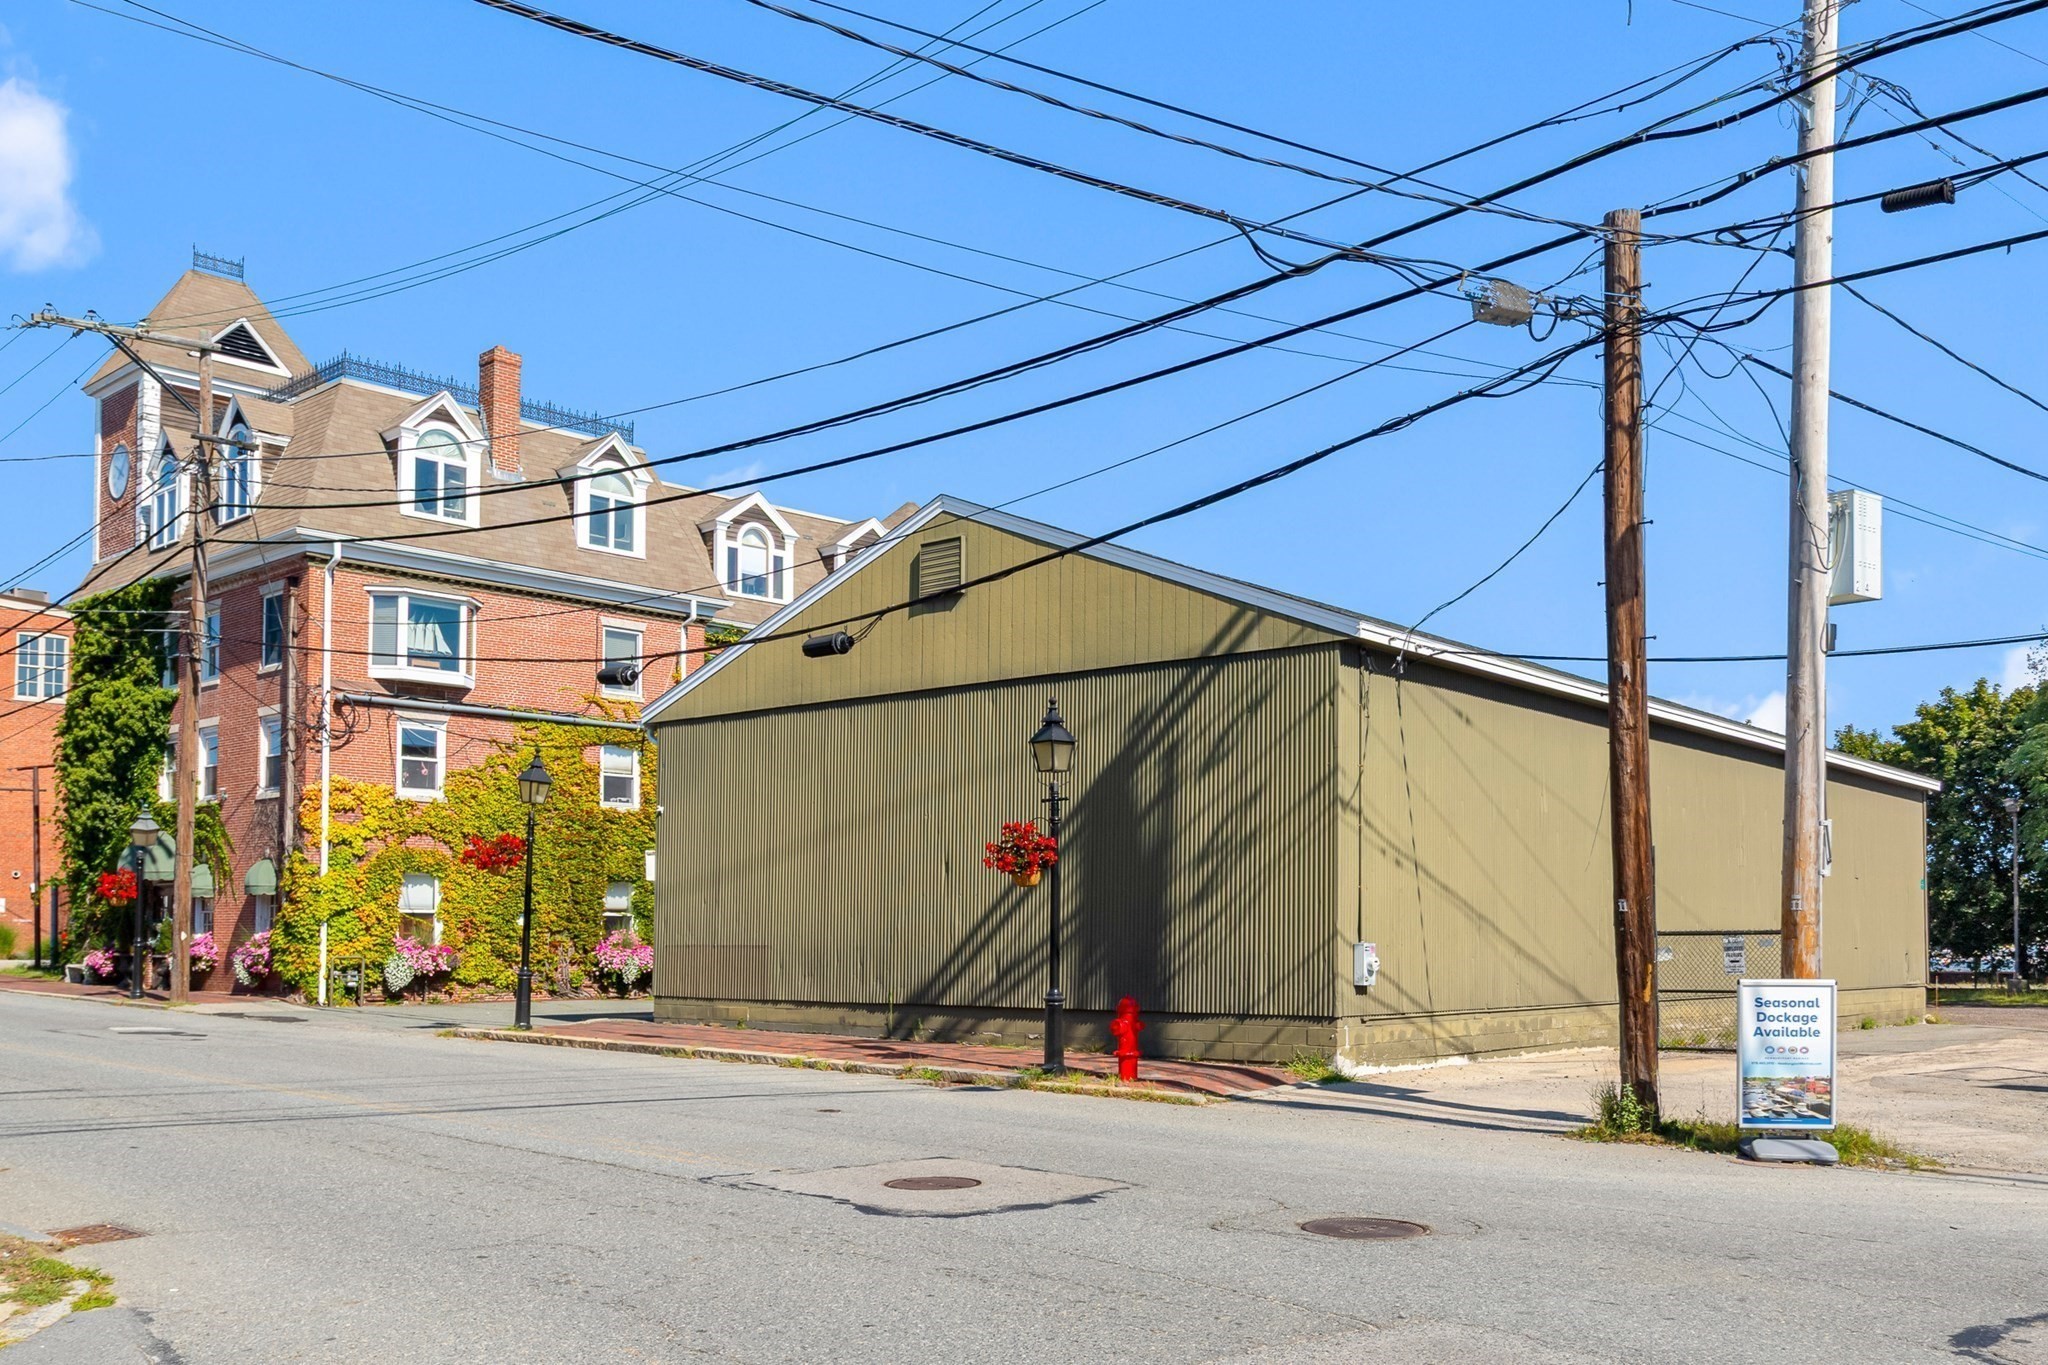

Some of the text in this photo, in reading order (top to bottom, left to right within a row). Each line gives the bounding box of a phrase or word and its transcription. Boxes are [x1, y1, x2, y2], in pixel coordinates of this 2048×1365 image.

[1754, 997, 1820, 1008] Seasonal
[1756, 1012, 1818, 1025] Dockage
[1753, 1026, 1821, 1038] Available
